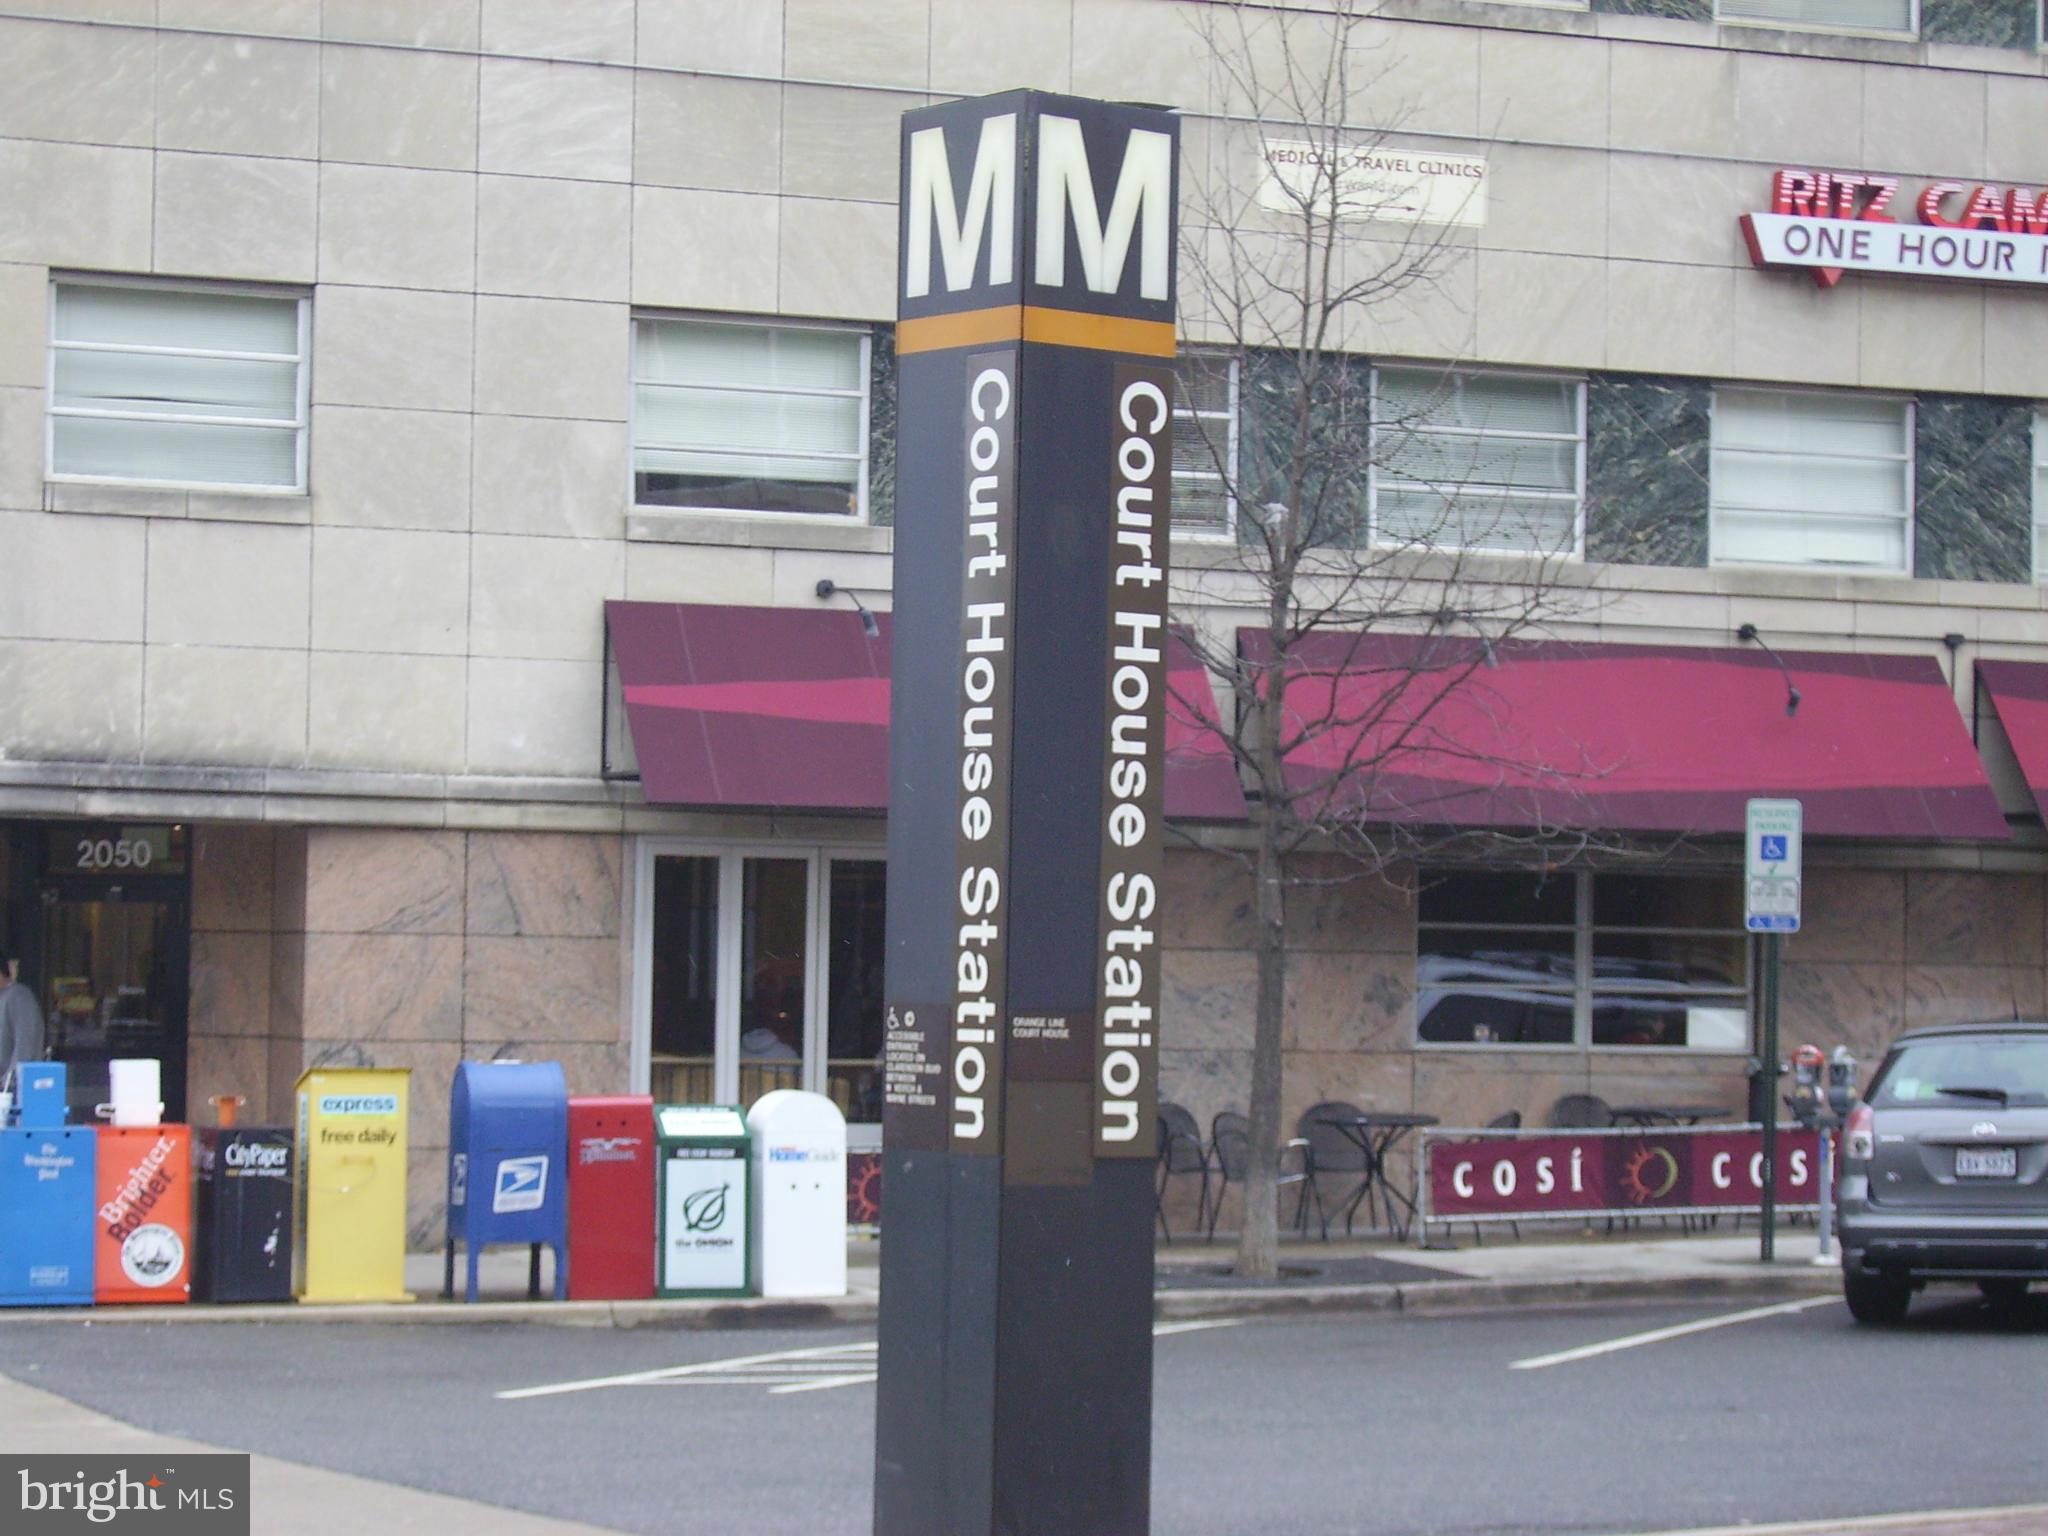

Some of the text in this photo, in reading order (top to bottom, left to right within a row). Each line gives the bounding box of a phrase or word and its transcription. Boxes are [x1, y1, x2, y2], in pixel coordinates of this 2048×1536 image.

[1355, 156, 1412, 173] TRAVEL
[1418, 161, 1482, 178] CLINICS
[907, 113, 1017, 298] M
[1035, 113, 1172, 301] M
[1772, 169, 1898, 222] RITZ
[1784, 225, 1871, 260] ONE
[1899, 233, 2016, 272] HOUR
[954, 369, 1010, 1139] Court House Station
[1102, 381, 1168, 1142] Court House Station
[77, 839, 151, 868] 2050
[1013, 1028, 1069, 1039] COURT HOUSE
[323, 1098, 394, 1113] express
[321, 1126, 397, 1147] free daily
